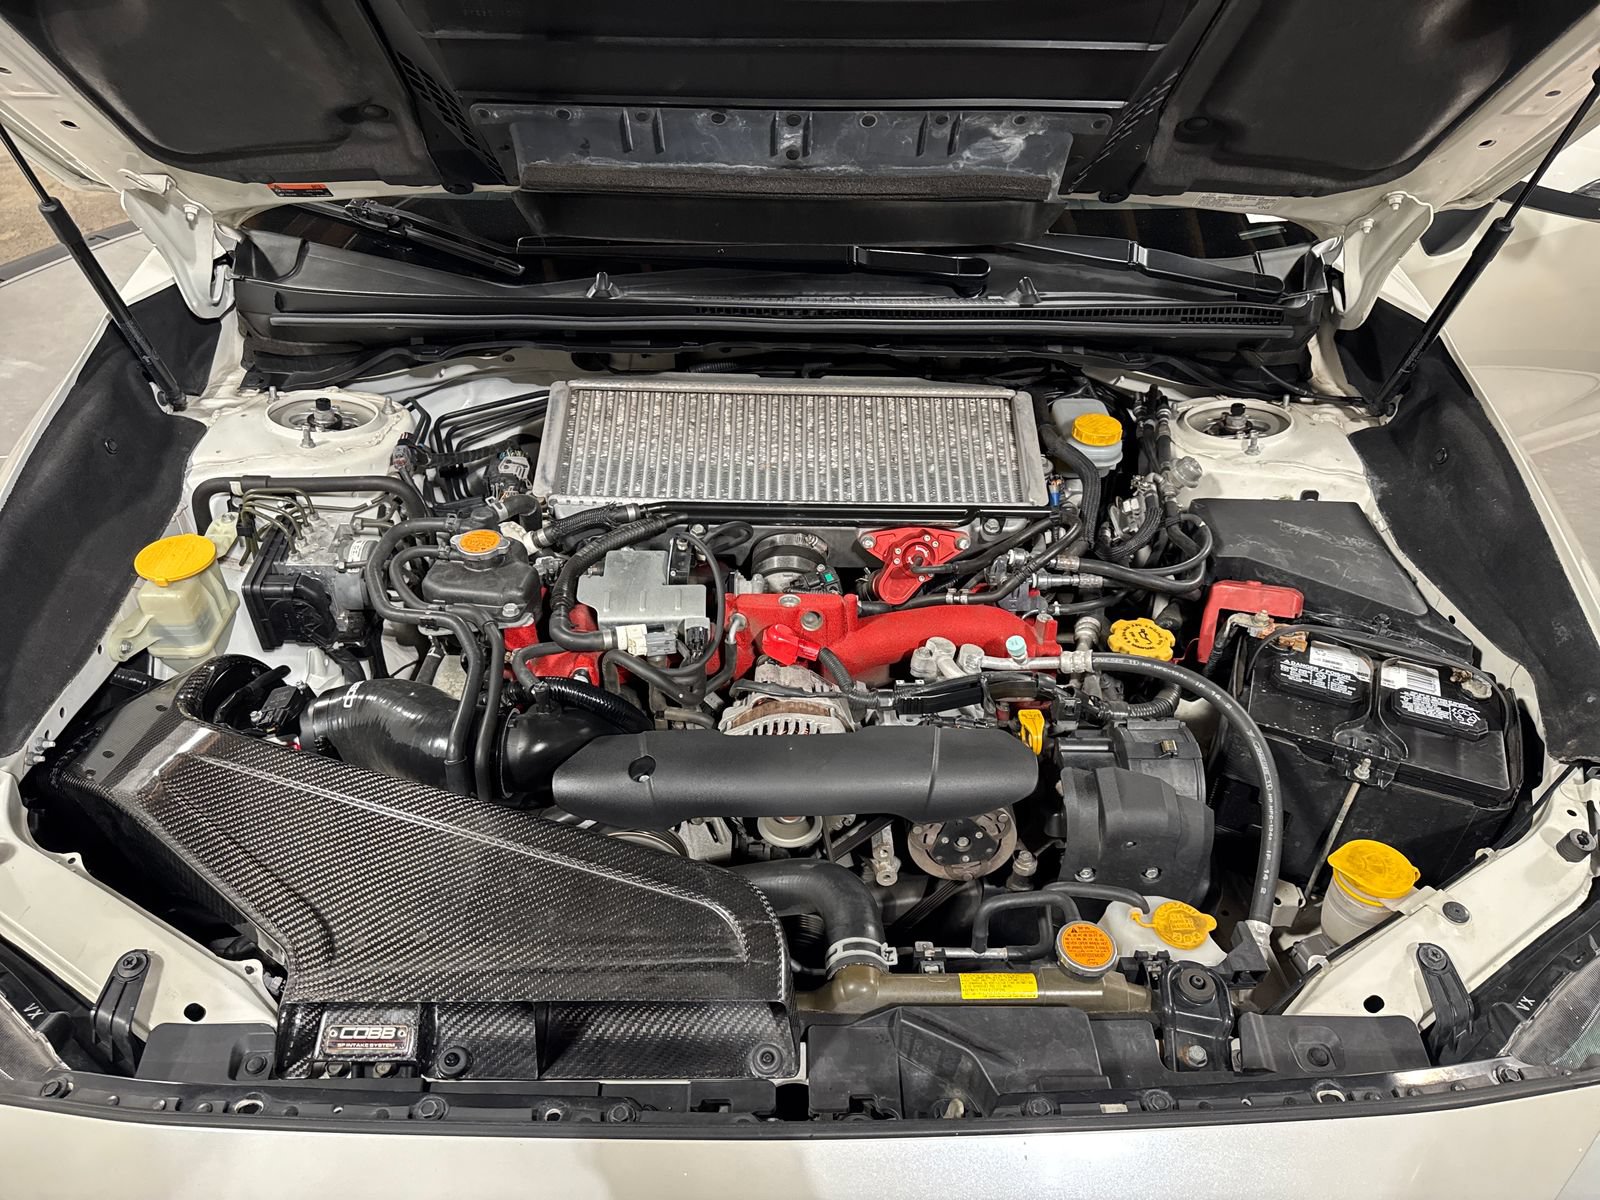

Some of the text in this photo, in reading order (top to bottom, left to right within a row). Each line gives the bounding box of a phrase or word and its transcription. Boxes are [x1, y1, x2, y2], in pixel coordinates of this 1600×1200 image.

[1291, 660, 1319, 672] DANGER
[1325, 669, 1352, 680] POISON
[339, 1027, 397, 1039] COBB
